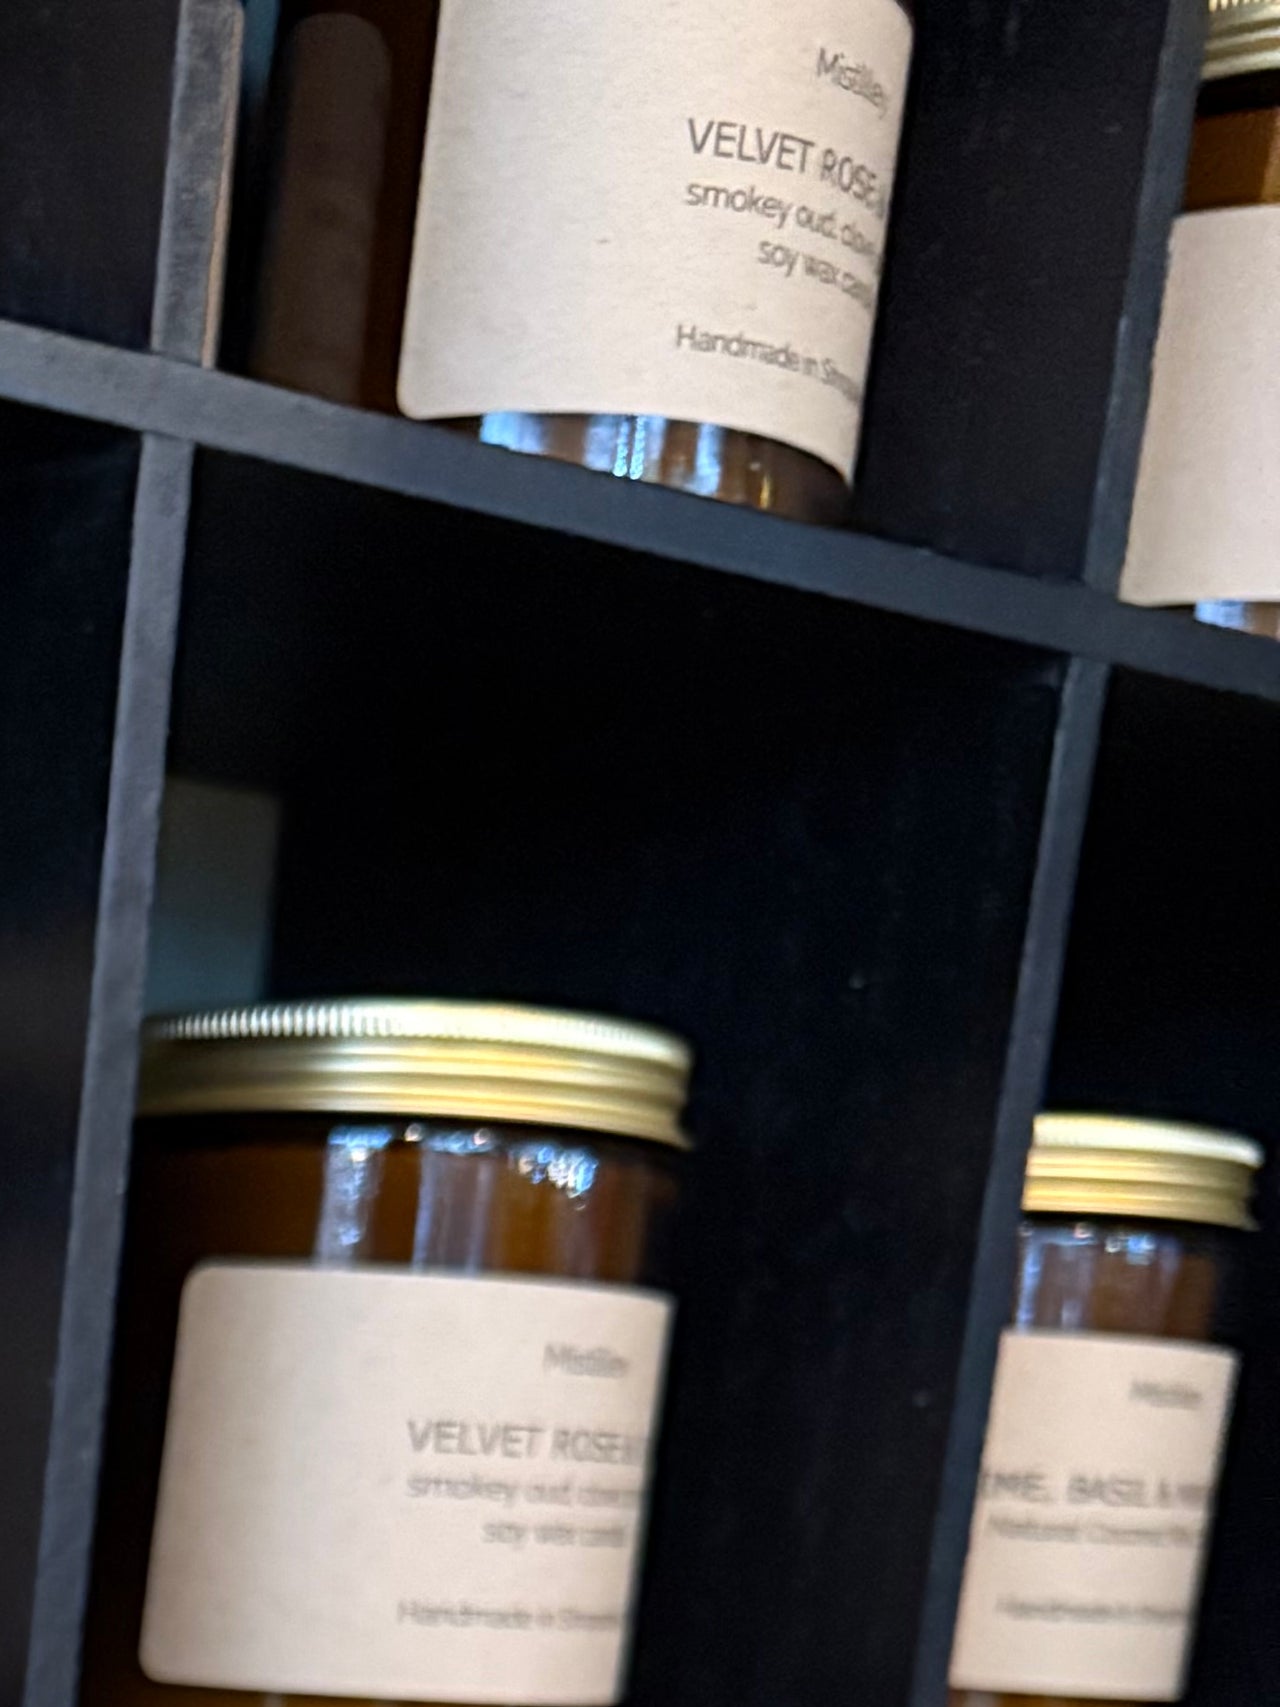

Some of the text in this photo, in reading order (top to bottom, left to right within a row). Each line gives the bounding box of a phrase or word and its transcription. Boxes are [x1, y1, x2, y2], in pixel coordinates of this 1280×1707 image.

[688, 118, 815, 174] VELVET
[687, 181, 793, 230] smokey
[758, 240, 801, 277] soy
[406, 1418, 546, 1459] VELVET
